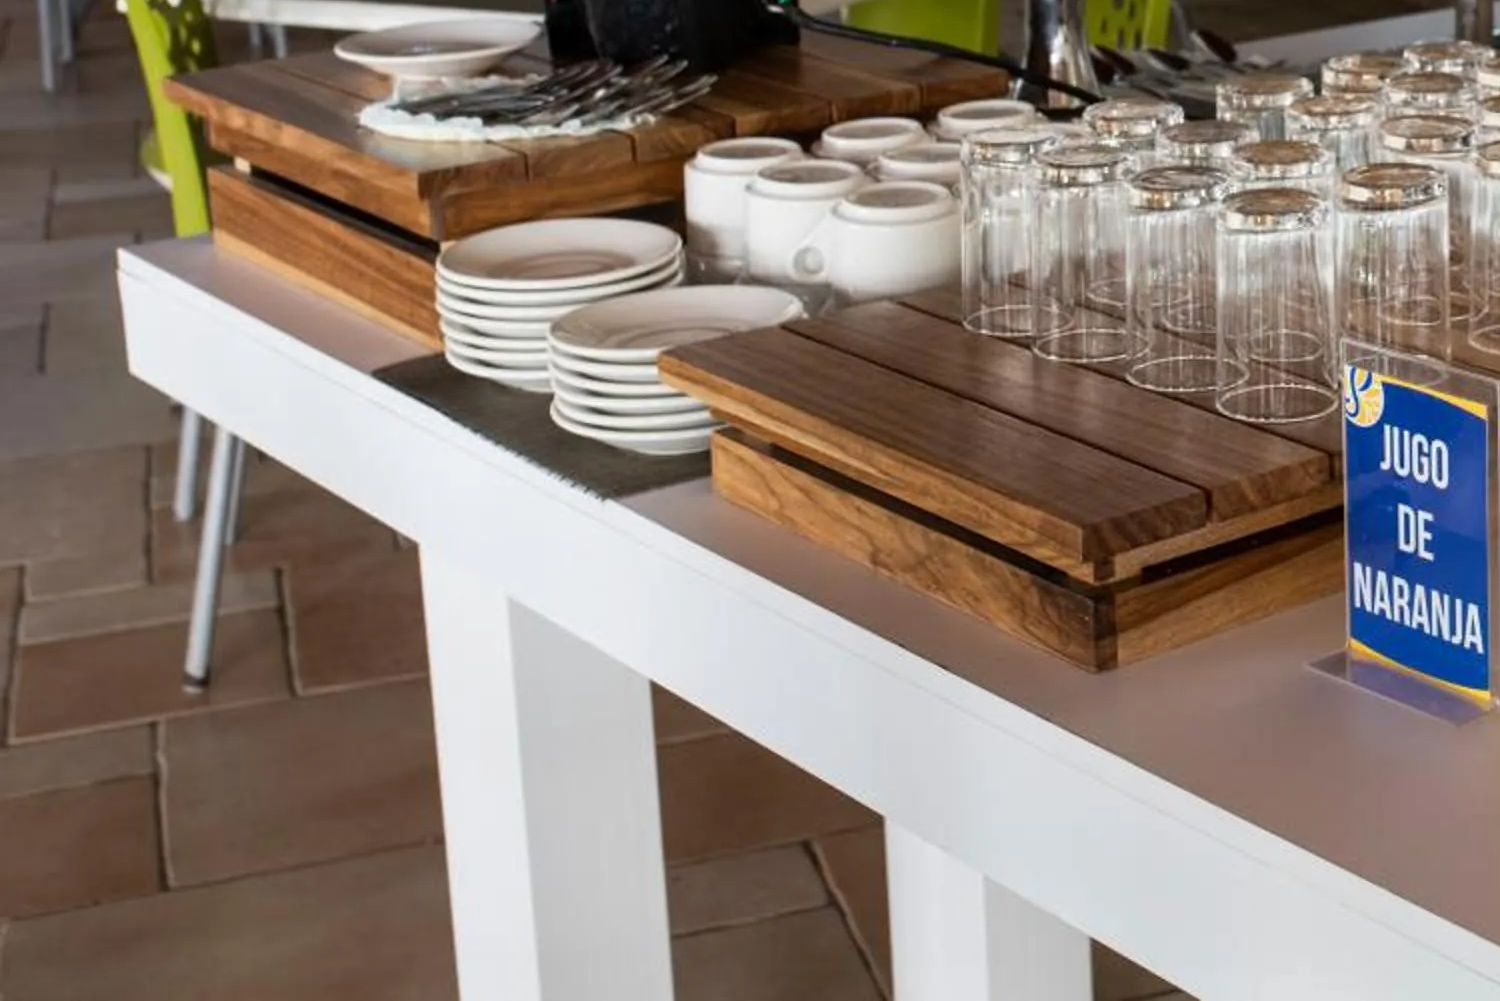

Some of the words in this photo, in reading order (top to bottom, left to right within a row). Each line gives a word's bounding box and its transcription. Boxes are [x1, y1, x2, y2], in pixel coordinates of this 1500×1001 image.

[1380, 424, 1449, 490] JUGO
[1397, 503, 1435, 562] DE
[1353, 561, 1484, 654] NARANJA
